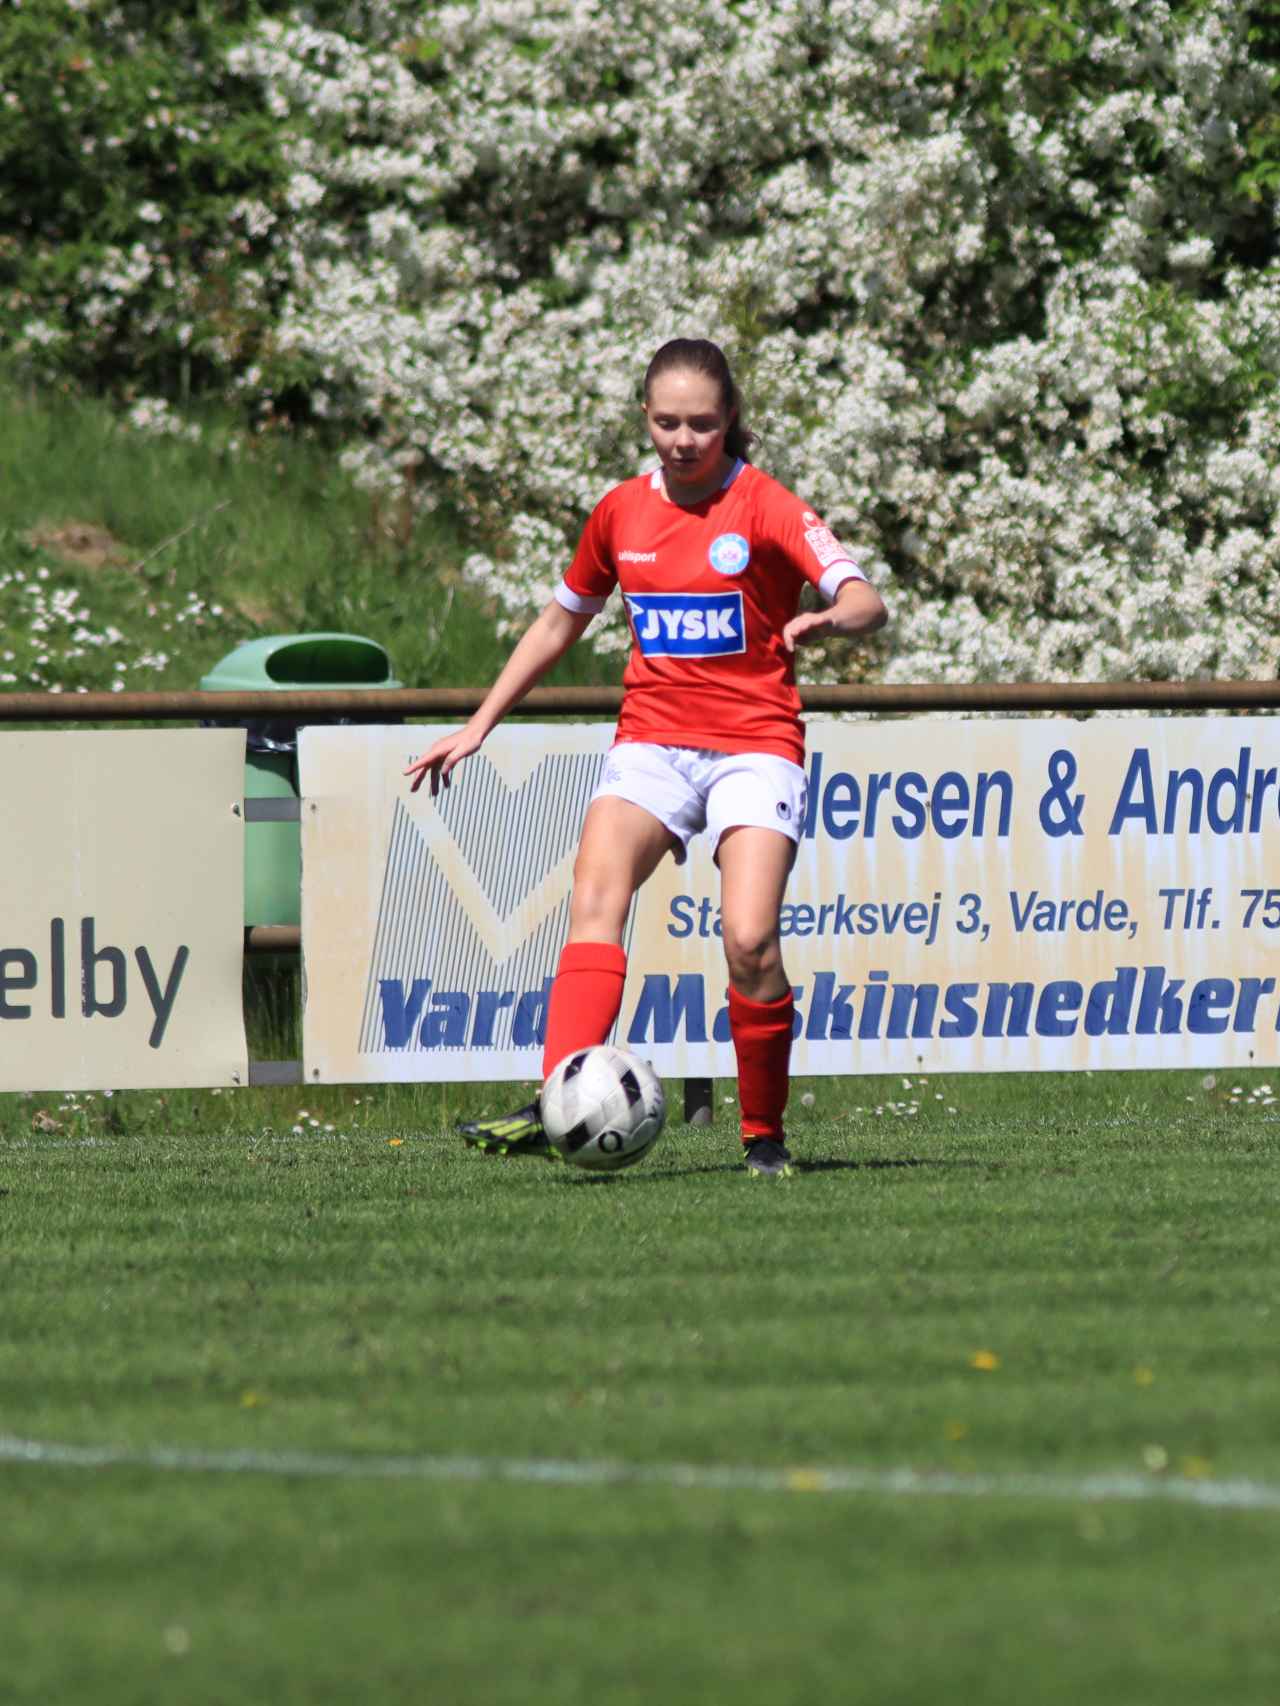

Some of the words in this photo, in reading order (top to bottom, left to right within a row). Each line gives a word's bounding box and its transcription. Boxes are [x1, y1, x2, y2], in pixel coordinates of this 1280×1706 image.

[618, 550, 656, 564] uhlsport
[641, 608, 738, 640] JYSK
[1039, 749, 1086, 838] &
[956, 893, 991, 942] 3,
[1009, 890, 1138, 939] Varde,
[1159, 887, 1221, 930] Tlf.
[379, 976, 556, 1050] Vard
